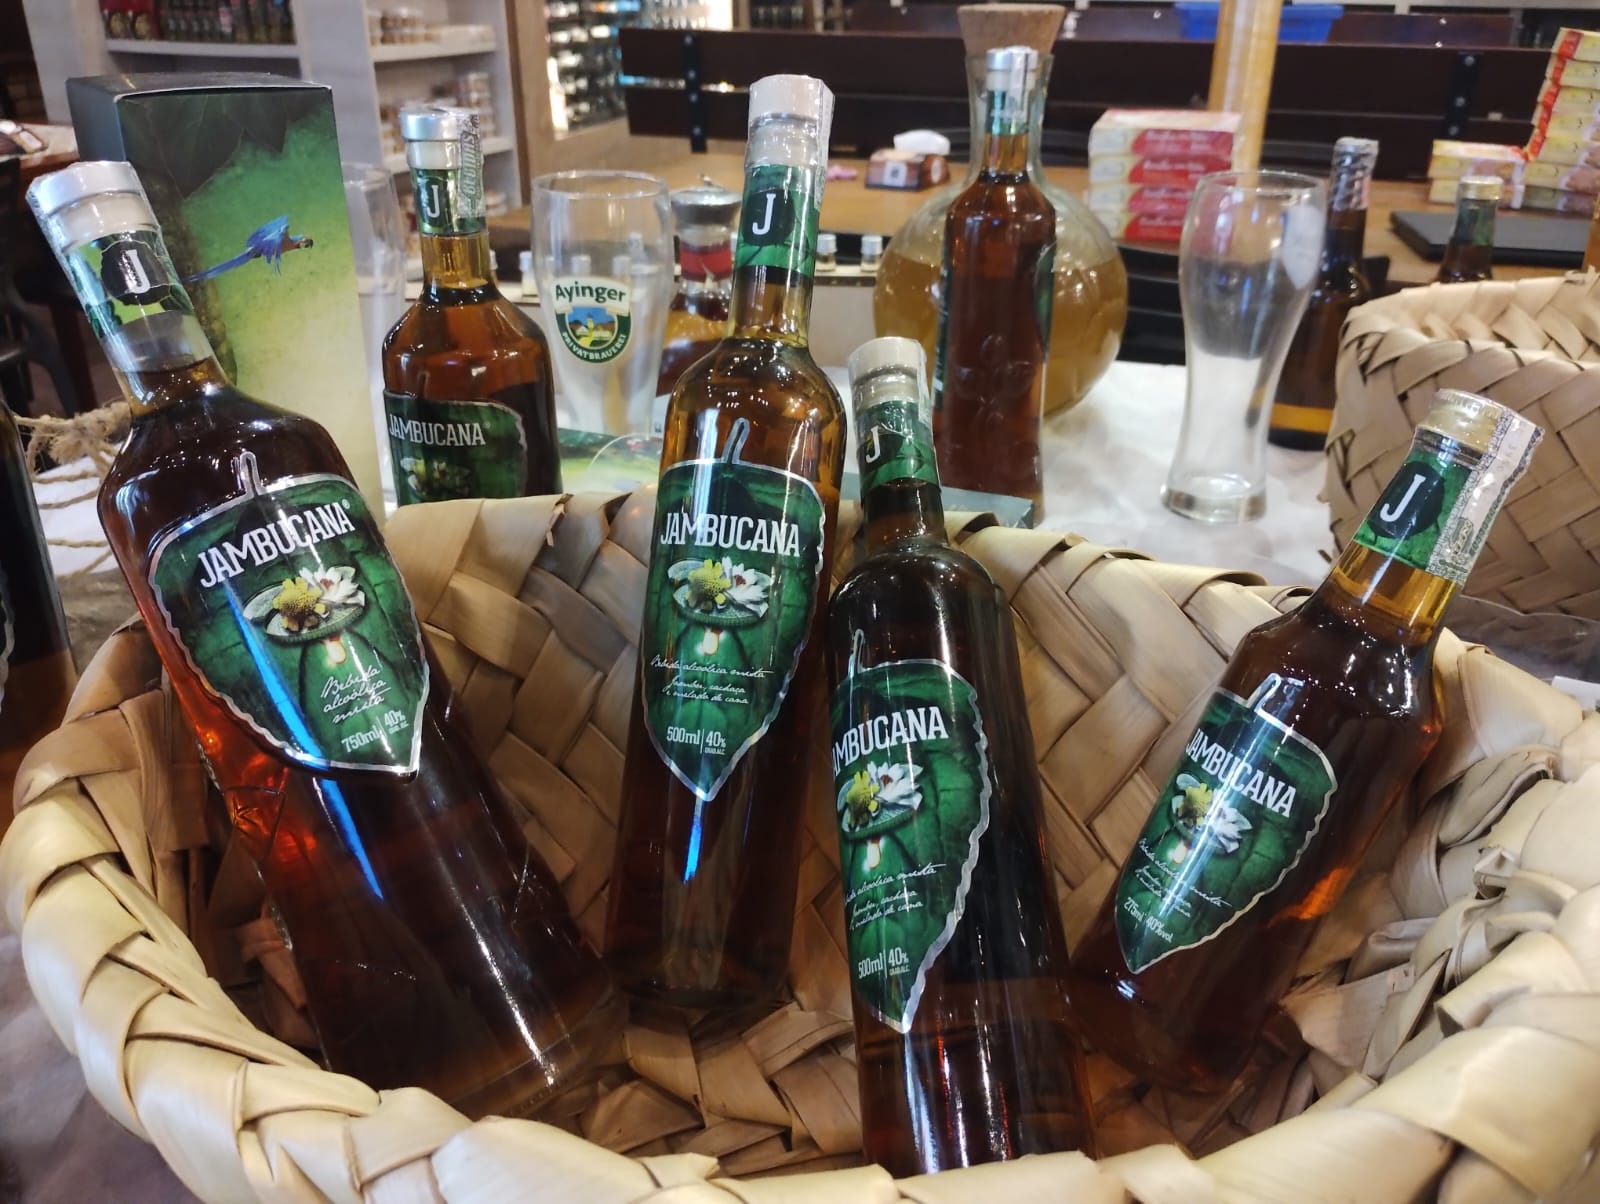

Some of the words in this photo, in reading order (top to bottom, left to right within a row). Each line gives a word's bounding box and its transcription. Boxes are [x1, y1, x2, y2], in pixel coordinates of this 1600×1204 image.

[427, 184, 441, 218] J
[752, 193, 777, 235] J
[555, 281, 626, 304] Ayinger
[866, 425, 881, 463] J
[1380, 474, 1426, 522] J
[660, 512, 800, 557] JAMBUCANA
[341, 725, 381, 753] 750ml
[667, 726, 700, 745] 500ml
[705, 731, 727, 748] 40%
[832, 706, 949, 782] AMBUCANA
[858, 952, 883, 979] 500ml
[888, 947, 910, 967] 40%
